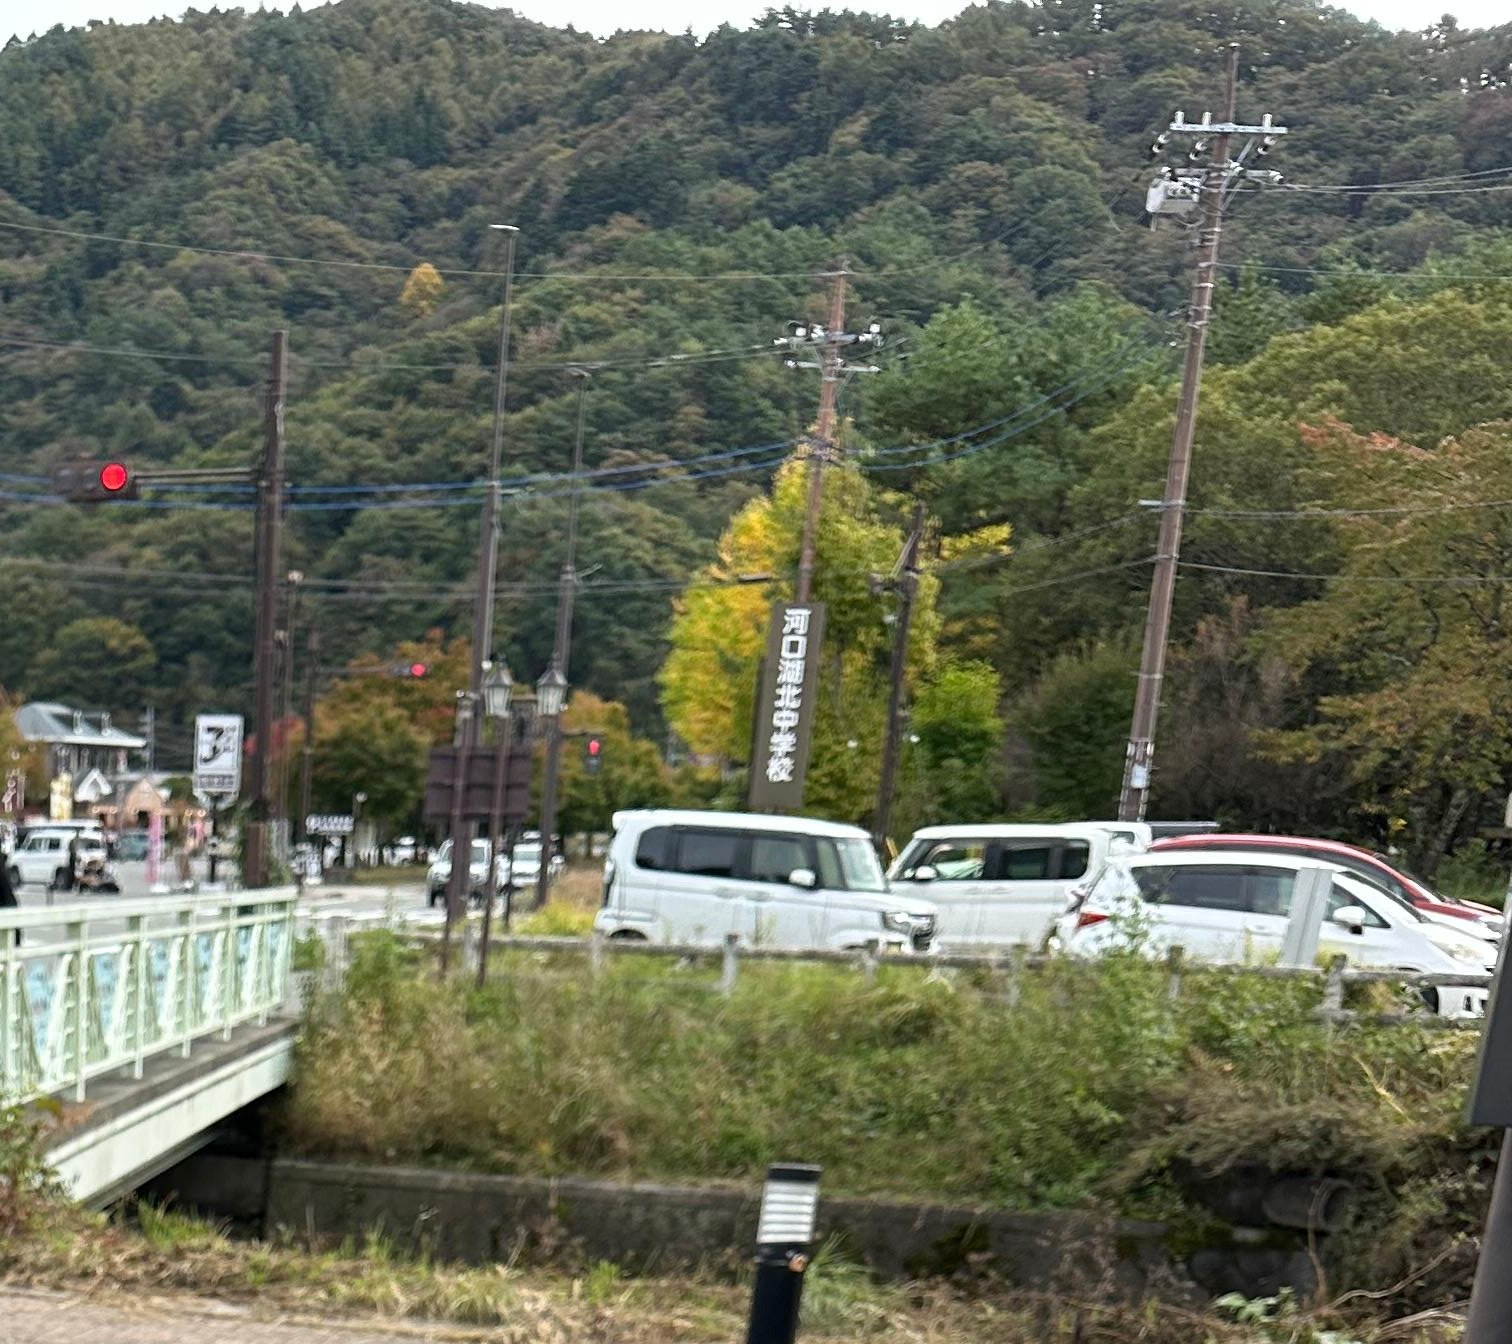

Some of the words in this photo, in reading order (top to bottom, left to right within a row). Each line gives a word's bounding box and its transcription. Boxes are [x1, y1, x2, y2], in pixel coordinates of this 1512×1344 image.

[766, 608, 813, 782] 河口湖北中学校
